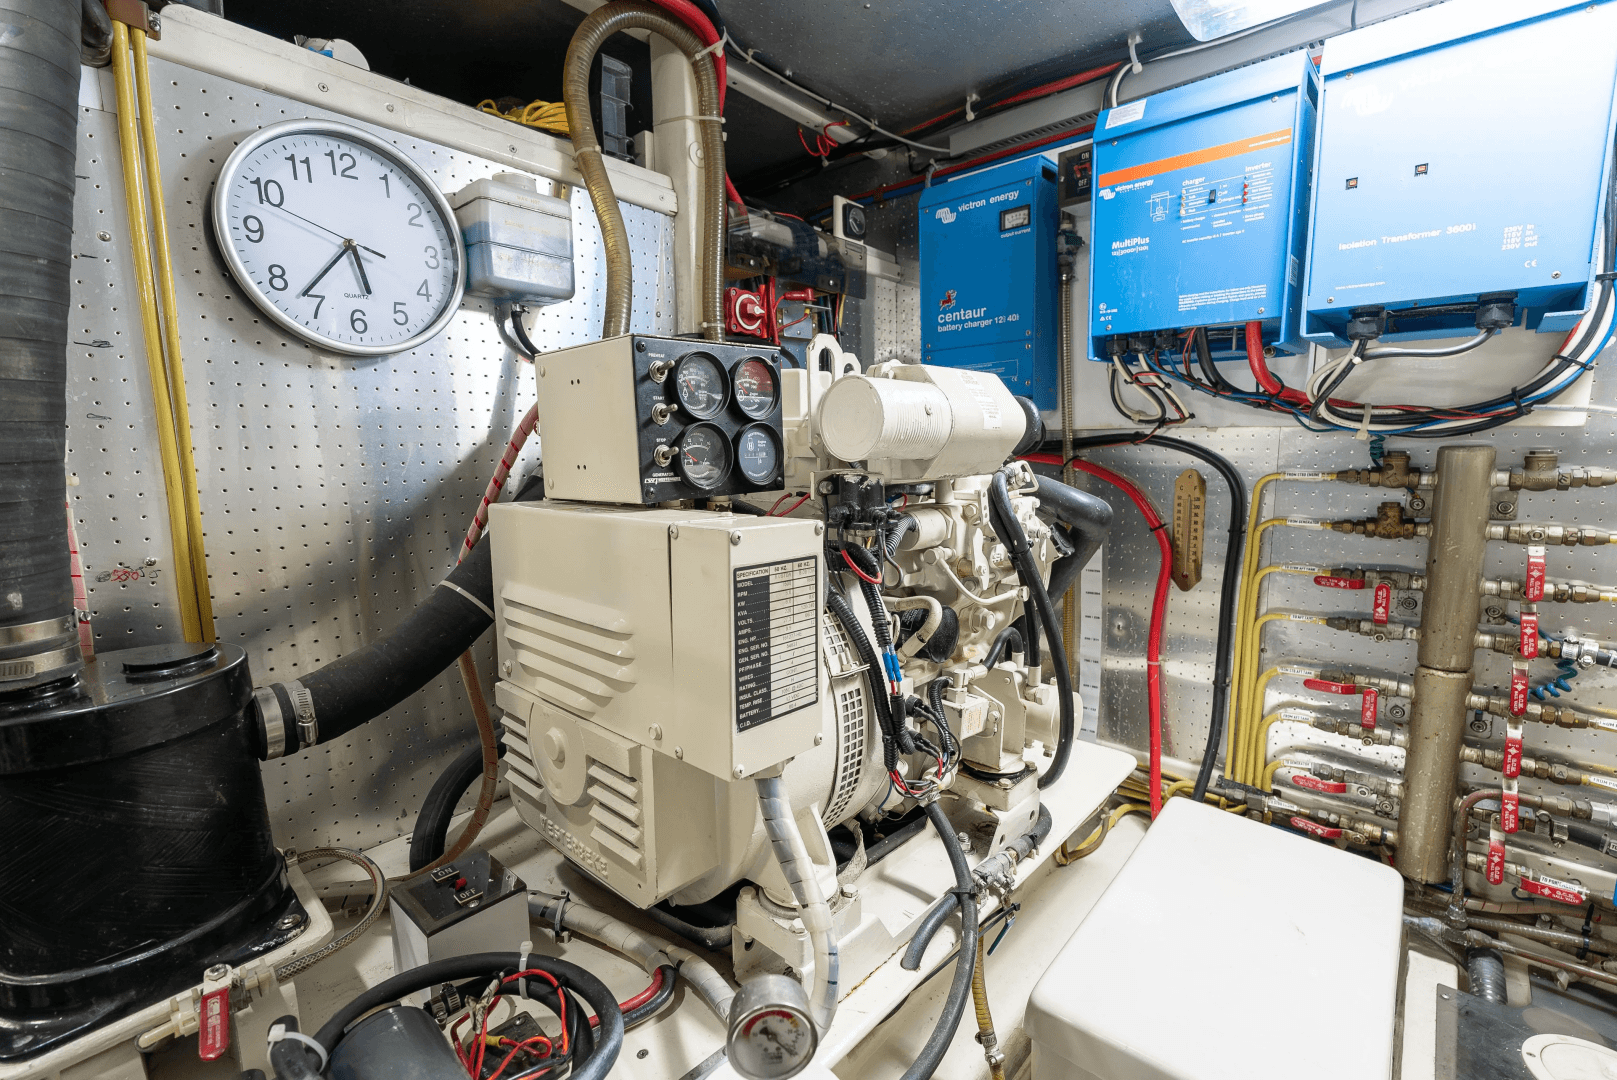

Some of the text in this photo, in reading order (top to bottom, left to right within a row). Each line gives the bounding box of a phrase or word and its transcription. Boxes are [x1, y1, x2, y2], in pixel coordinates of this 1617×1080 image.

[284, 154, 312, 184] 11
[324, 150, 358, 180] 12
[1245, 162, 1272, 172] inverter
[250, 176, 284, 208] 10
[379, 174, 390, 198] 1
[1182, 176, 1206, 186] charger
[958, 190, 1020, 213] victron energy
[407, 202, 424, 228] 2
[243, 215, 264, 243] 9
[1338, 238, 1377, 251] Isolation
[1382, 228, 1442, 245] Transformer
[1112, 236, 1150, 249] MultiPlus
[424, 246, 440, 269] 3
[268, 264, 289, 291] 8
[416, 279, 432, 302] 4
[306, 294, 326, 319] 7
[393, 302, 408, 326] 5
[938, 306, 986, 323] centaur
[350, 309, 368, 334] 6
[938, 322, 962, 332] battery
[964, 318, 992, 329] charger
[736, 567, 768, 579] SPECIFICATION
[739, 707, 759, 720] BATTERY
[540, 813, 608, 879] WESTERBEKE
[438, 867, 453, 876] ON
[460, 888, 476, 898] OFF
